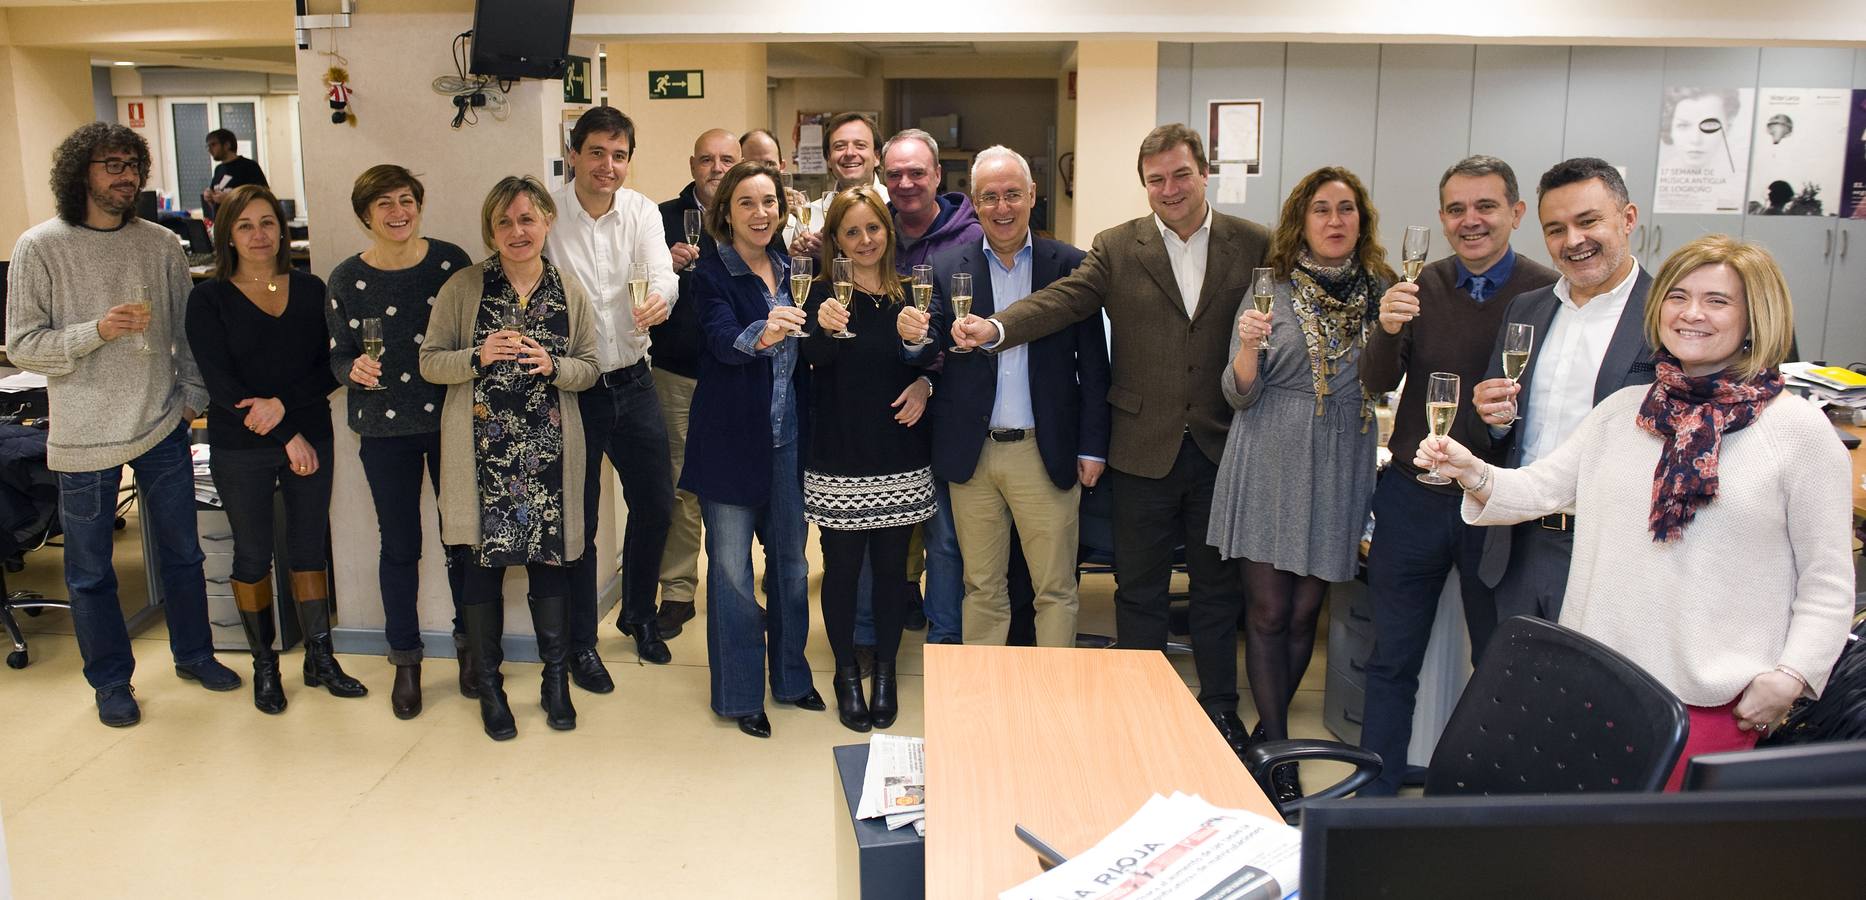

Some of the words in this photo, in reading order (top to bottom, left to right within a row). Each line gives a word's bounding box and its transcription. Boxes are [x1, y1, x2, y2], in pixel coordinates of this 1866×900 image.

[1671, 168, 1702, 176] SEMANA
[1703, 168, 1714, 176] DE
[1658, 185, 1668, 193] DE
[1093, 842, 1166, 886] RIOJA
